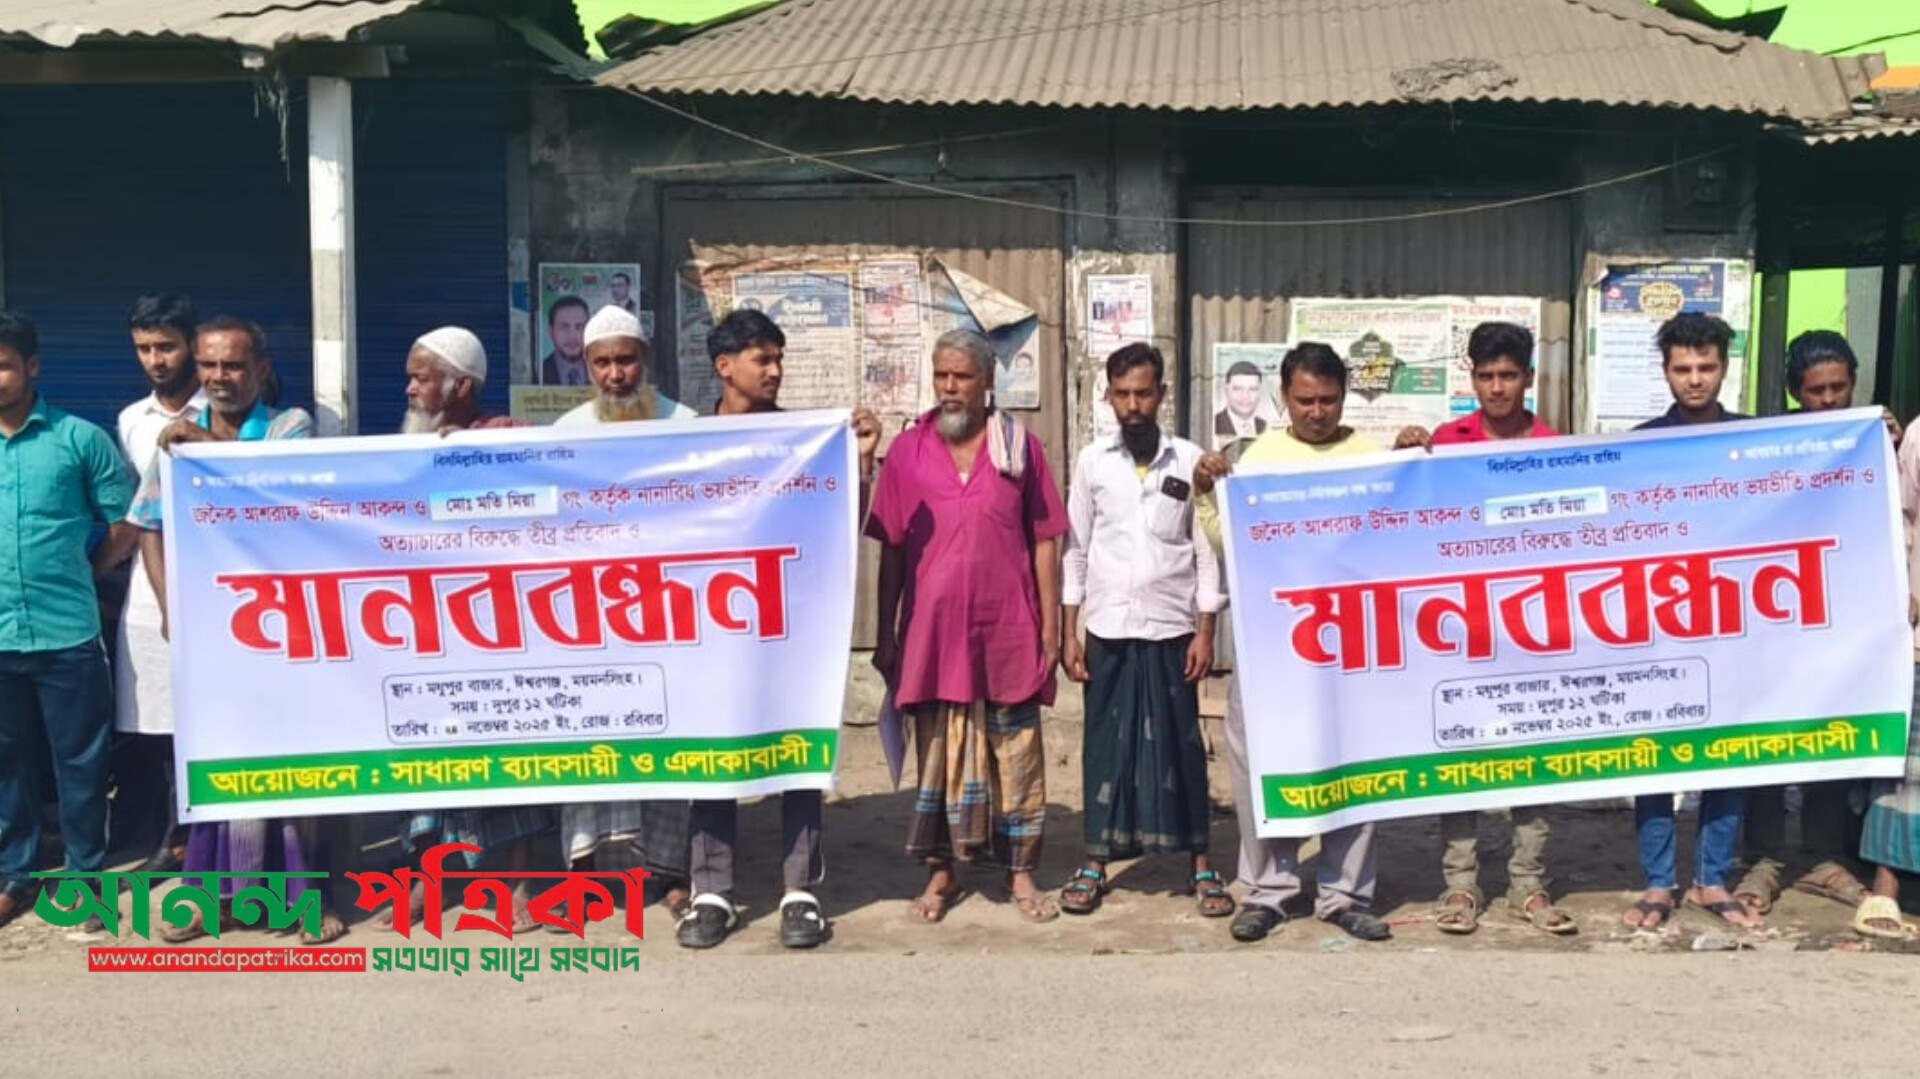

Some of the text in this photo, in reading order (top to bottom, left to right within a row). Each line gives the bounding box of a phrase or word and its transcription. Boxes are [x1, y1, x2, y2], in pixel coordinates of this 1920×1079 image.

[193, 504, 237, 525] জনৈক
[245, 502, 299, 524] আশরাফ
[358, 500, 406, 519] আকন্দ
[415, 502, 425, 517] ও
[447, 497, 472, 513] মোঃ
[476, 492, 501, 511] মতি
[589, 483, 631, 514] কর্তৃক
[638, 479, 693, 506] নানাবিধ
[823, 477, 836, 491] ও
[1250, 466, 1873, 543] জনৈক আশরাফ উদ্দিন আকন্দ ও মোঃ মতি মিয়া গং কর্তৃক নানাবিধ ভয়ভীতি প্রদর্শন ও
[379, 532, 462, 553] অত্যাচারের
[469, 525, 521, 549] বিরুদ্ধে
[527, 521, 557, 547] তীব্র
[1437, 518, 1688, 558] অত্যাচারের বিরুদ্ধে তীব্র প্রতিবাদ ও
[217, 546, 800, 662] মানববন্ধন
[1274, 536, 1840, 674] মানববন্ধন
[391, 719, 428, 736] তারিখ
[513, 718, 550, 732] ২০২৫
[623, 709, 663, 727] রবিবার
[492, 699, 520, 714] দুপুর
[524, 698, 541, 711] ১২
[545, 692, 581, 709] ঘটিকা
[1538, 698, 1564, 714] দুপুর
[1569, 697, 1586, 710] ১২
[1590, 690, 1626, 706] ঘটিকা
[1556, 715, 1593, 731] ২০২৫
[1666, 702, 1705, 720] রবিবার
[208, 763, 360, 797] আয়োজনে
[388, 754, 491, 786] সাধারণ
[500, 744, 622, 781] ব্যাবসায়ী
[631, 751, 655, 774] ও
[665, 733, 812, 776] এলাকাবাসী
[1280, 767, 1408, 811] আয়োজনে
[1435, 754, 1535, 787] সাধারণ
[1543, 738, 1661, 779] ব্যাবসায়ী
[1670, 741, 1694, 763] ও
[1704, 720, 1859, 763] এলাকাবাসী
